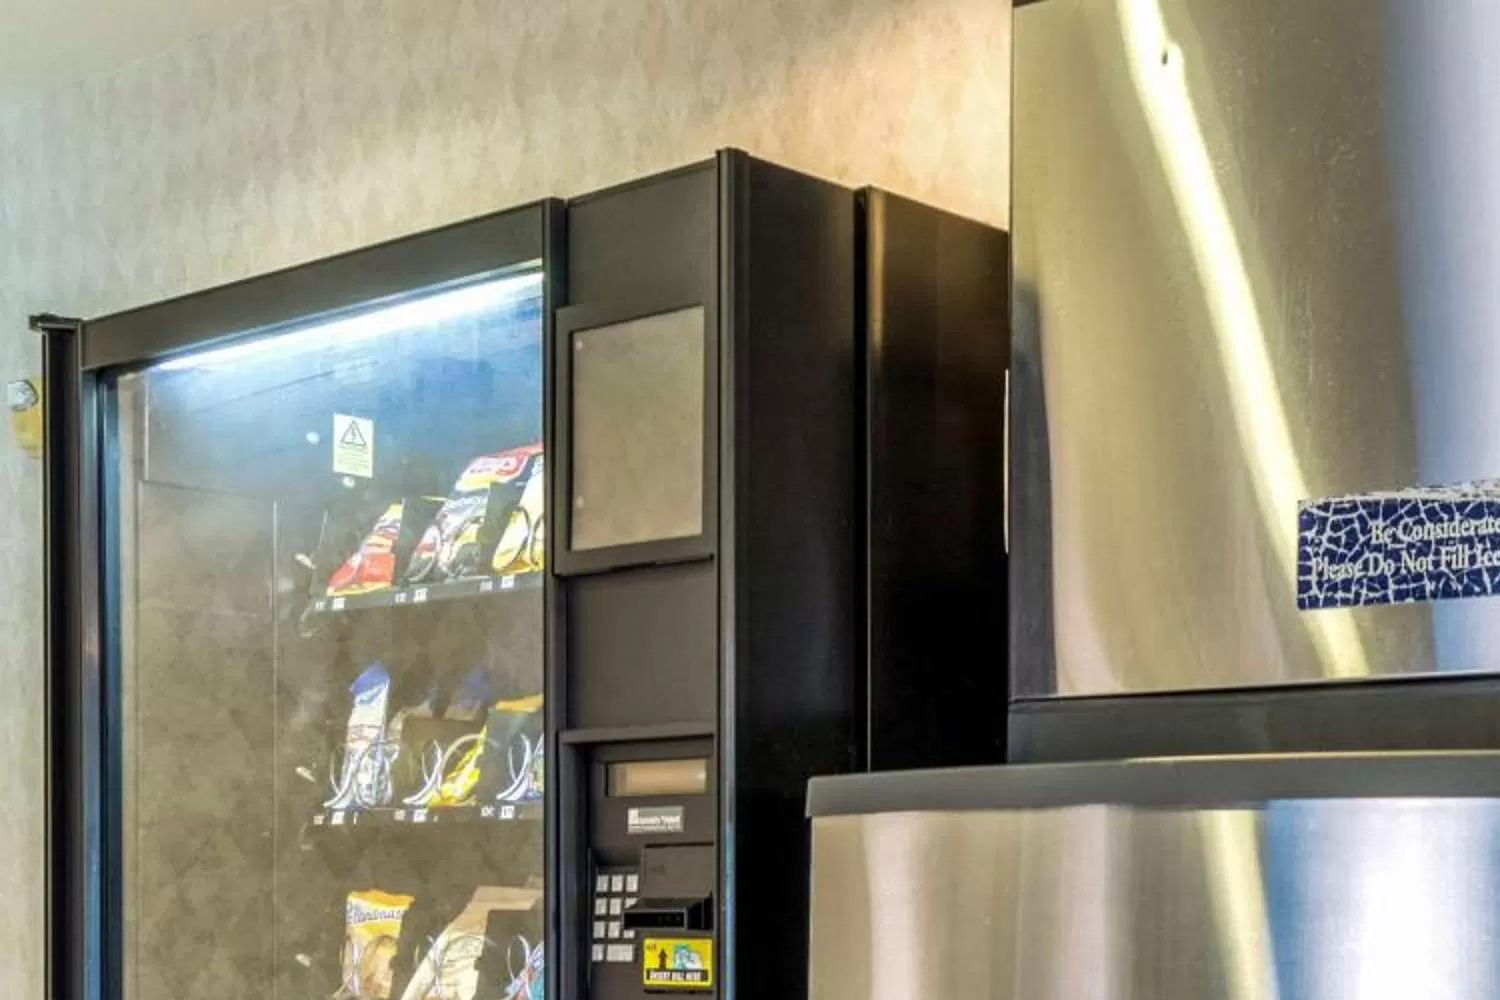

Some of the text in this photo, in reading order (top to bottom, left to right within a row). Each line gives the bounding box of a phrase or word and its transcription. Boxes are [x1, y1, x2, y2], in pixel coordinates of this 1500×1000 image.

[1371, 521, 1398, 545] Be
[1312, 555, 1362, 581] Please
[1366, 552, 1395, 577] Do
[1400, 548, 1434, 575] Not
[1440, 542, 1469, 570] Fill
